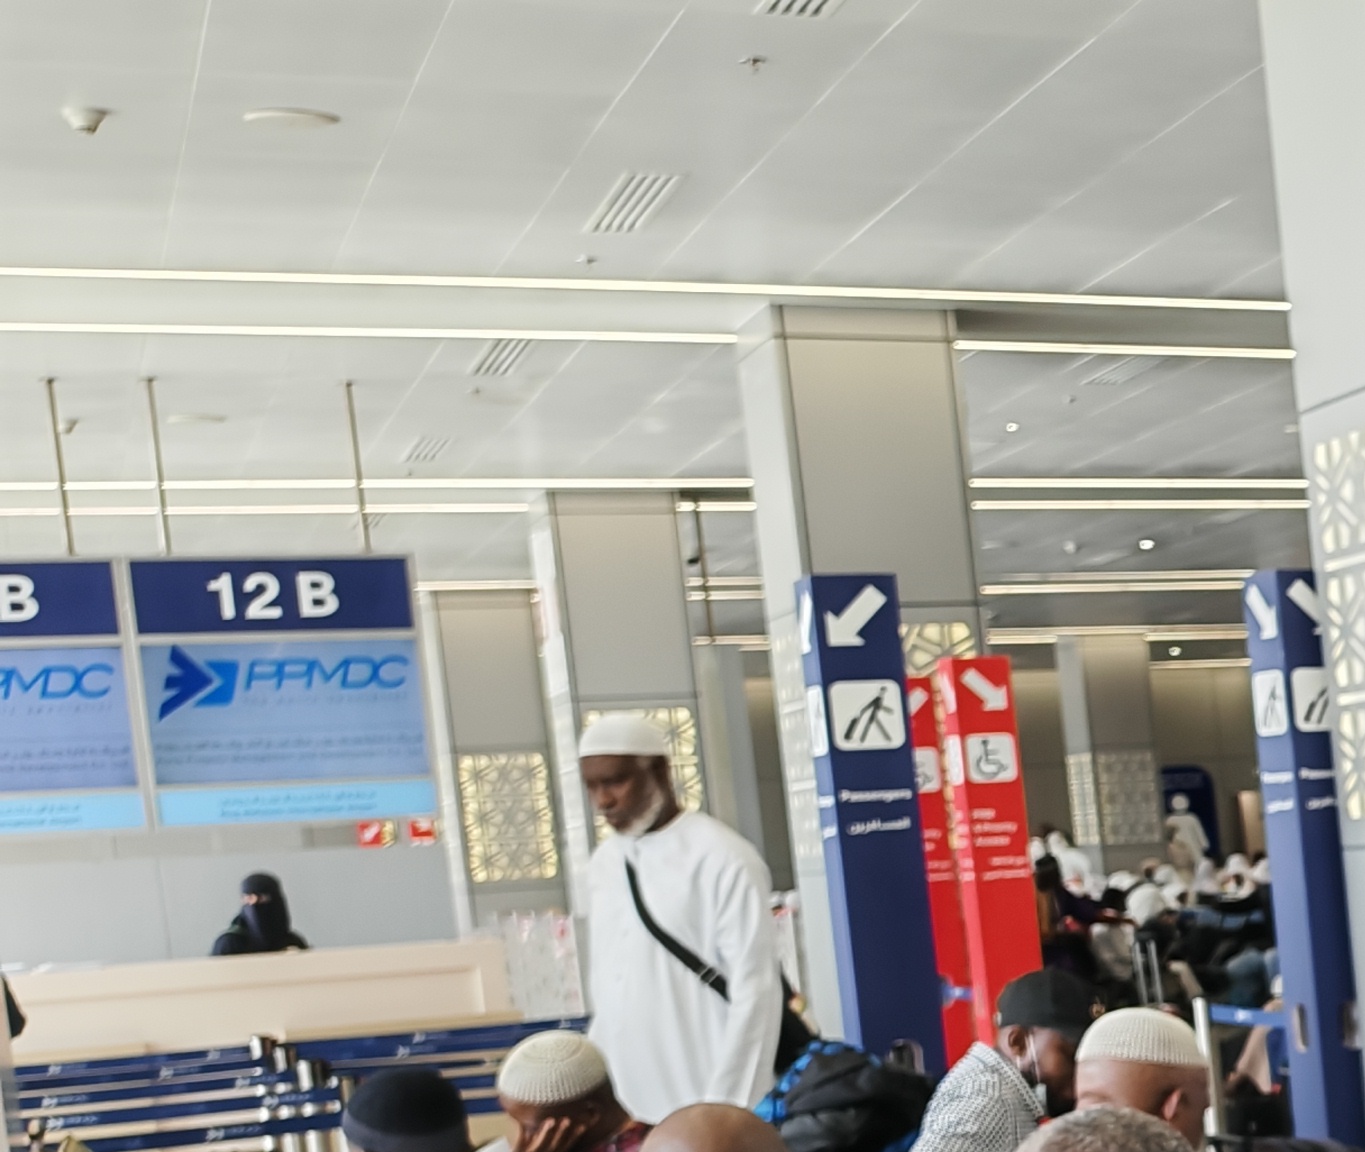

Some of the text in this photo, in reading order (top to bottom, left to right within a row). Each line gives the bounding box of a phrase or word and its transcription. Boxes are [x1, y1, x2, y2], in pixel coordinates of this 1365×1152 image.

[0, 574, 40, 622] B
[206, 571, 340, 620] 12 B
[0, 663, 115, 700] MDC
[245, 654, 409, 692] PPMDC
